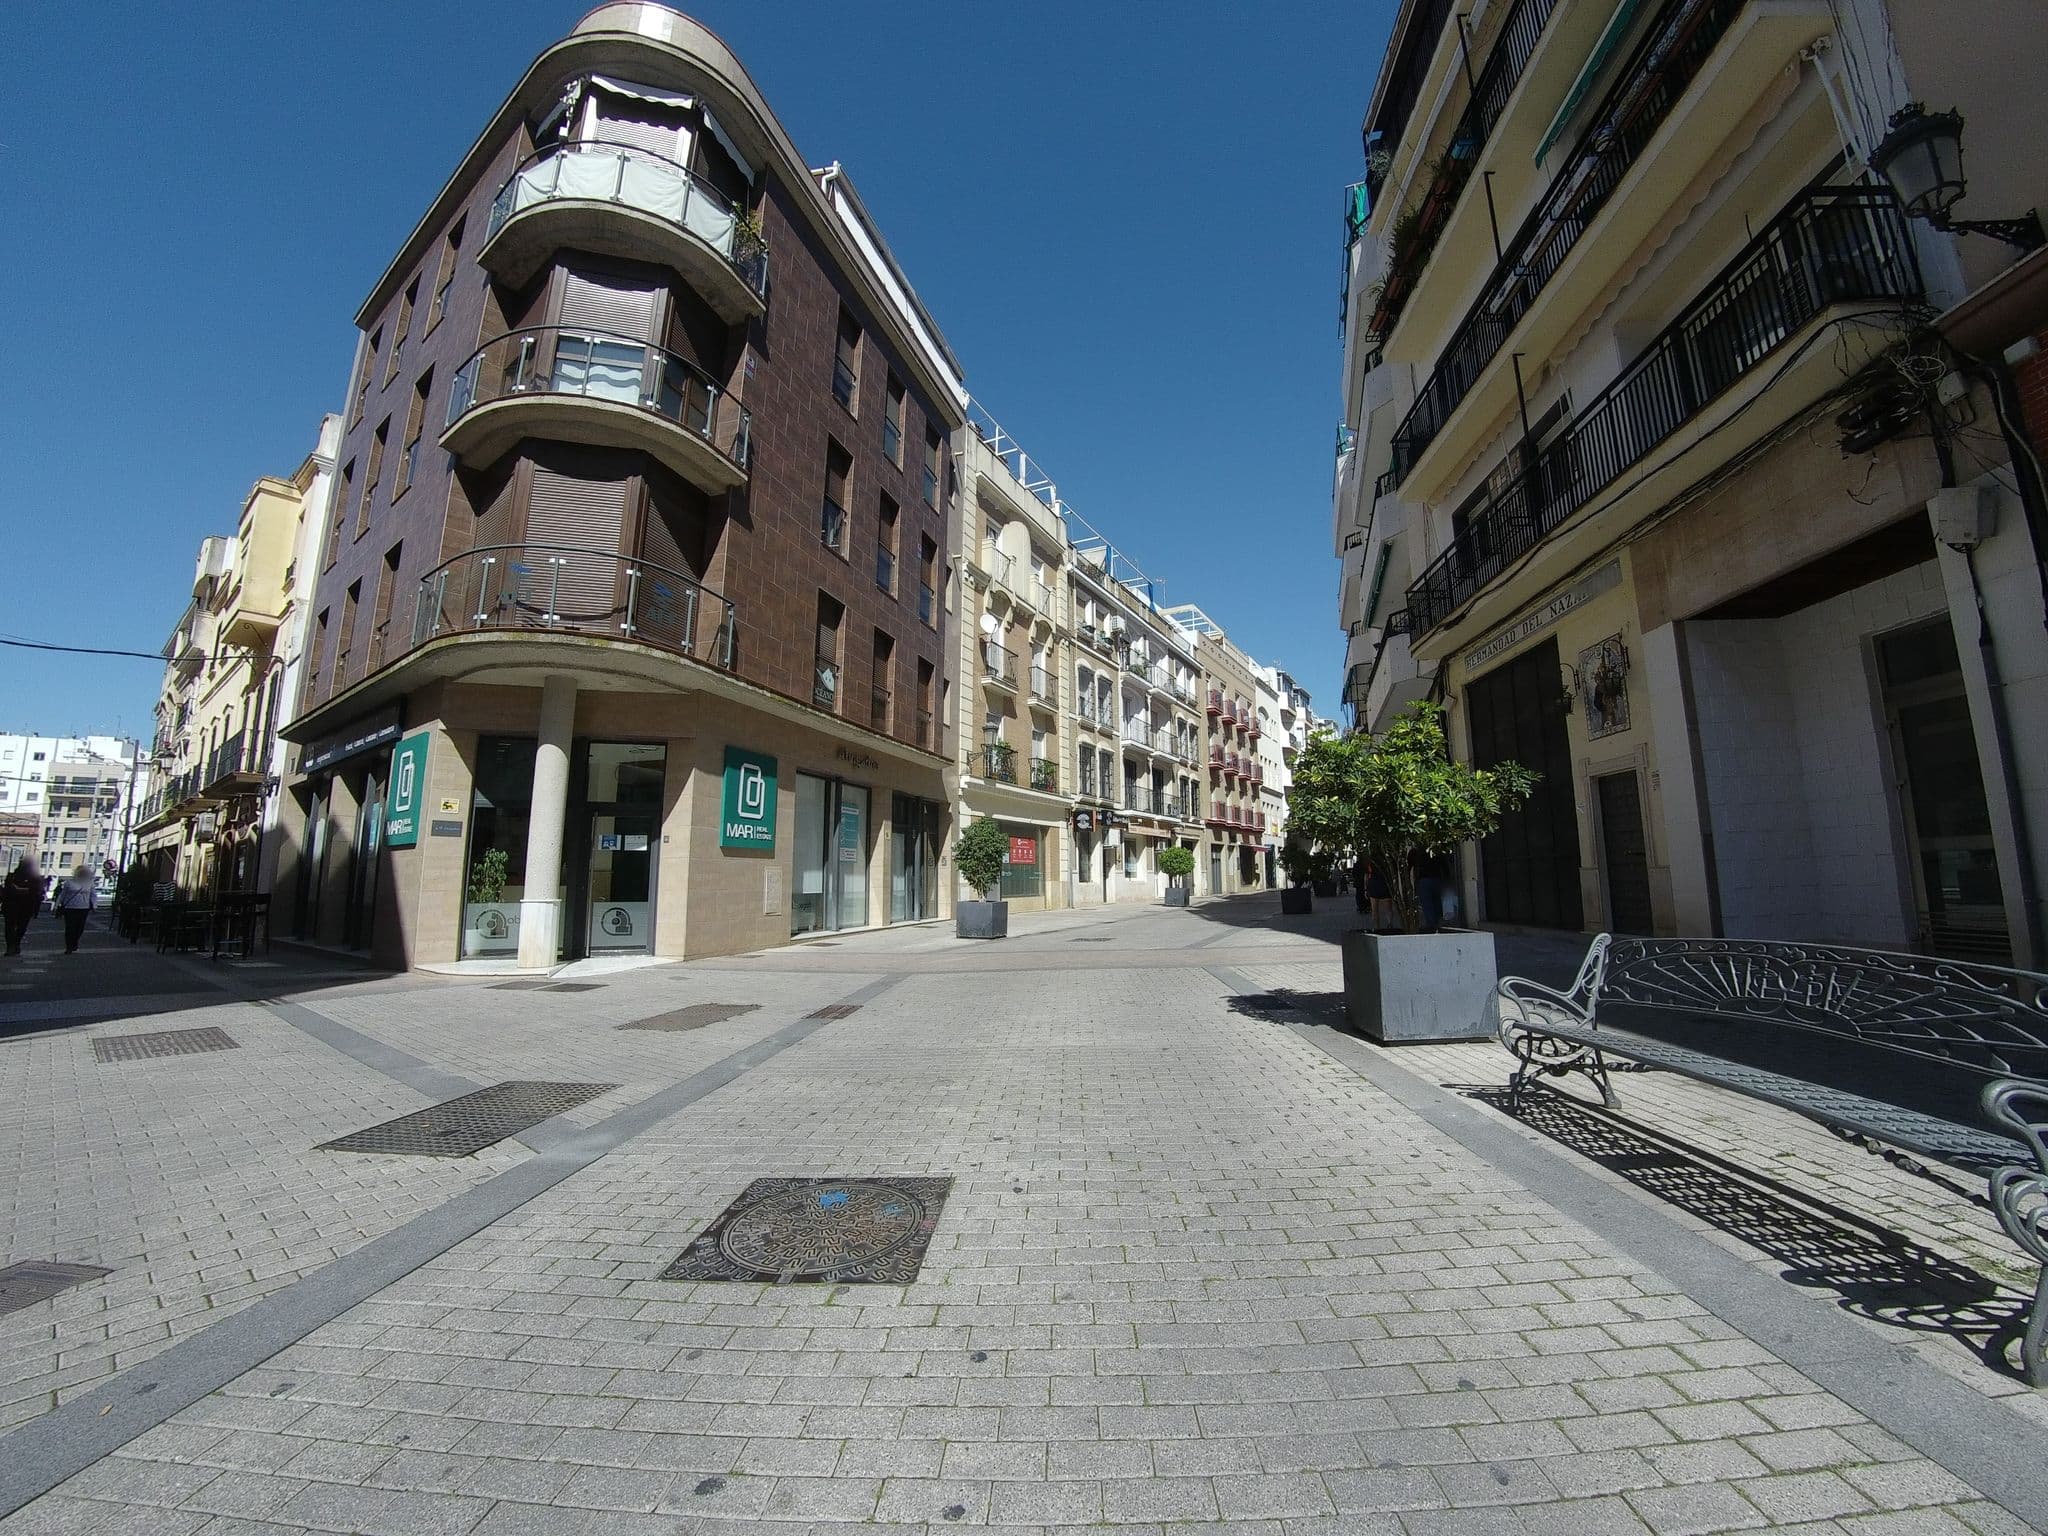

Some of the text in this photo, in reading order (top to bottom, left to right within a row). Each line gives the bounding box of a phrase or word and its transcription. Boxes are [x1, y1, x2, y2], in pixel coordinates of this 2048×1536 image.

[1466, 630, 1516, 668] HERMANDAD
[1522, 615, 1543, 635] DEL
[726, 822, 754, 839] MAR
